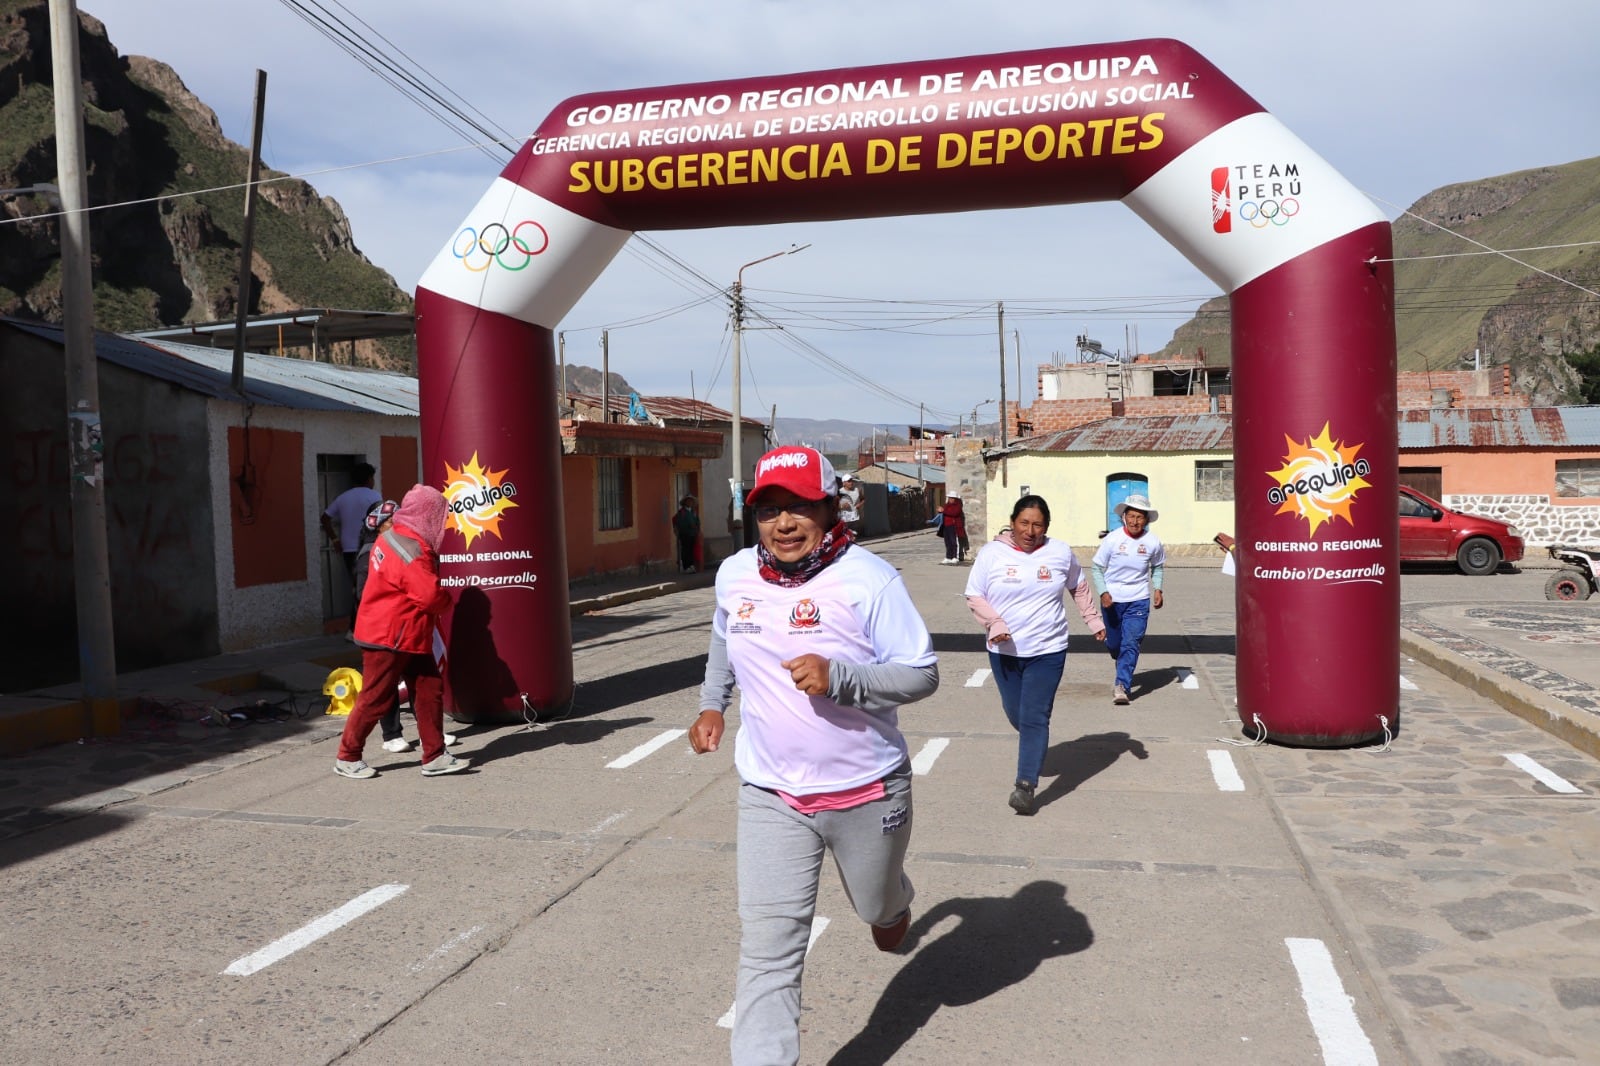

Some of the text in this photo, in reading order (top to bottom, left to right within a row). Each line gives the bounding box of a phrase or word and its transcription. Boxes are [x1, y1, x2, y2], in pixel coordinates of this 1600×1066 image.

[566, 55, 1159, 126] GOBIERNO REGIONAL DE AREQUIPA
[532, 81, 1194, 155] GERENCIA REGIONAL DE DESARROLLO E INCLUSIÓN SOCIAL
[568, 112, 1166, 193] SUBGERENCIA DE DEPORTES
[1235, 163, 1299, 180] TEAM
[1239, 178, 1301, 200] PERÚ
[1268, 459, 1370, 504] arequipa
[448, 482, 516, 514] equipa
[439, 550, 533, 563] BIERNO REGIONAL
[1255, 538, 1383, 552] GOBIERNO REGIONAL
[440, 571, 537, 587] mbioYDesarrollo
